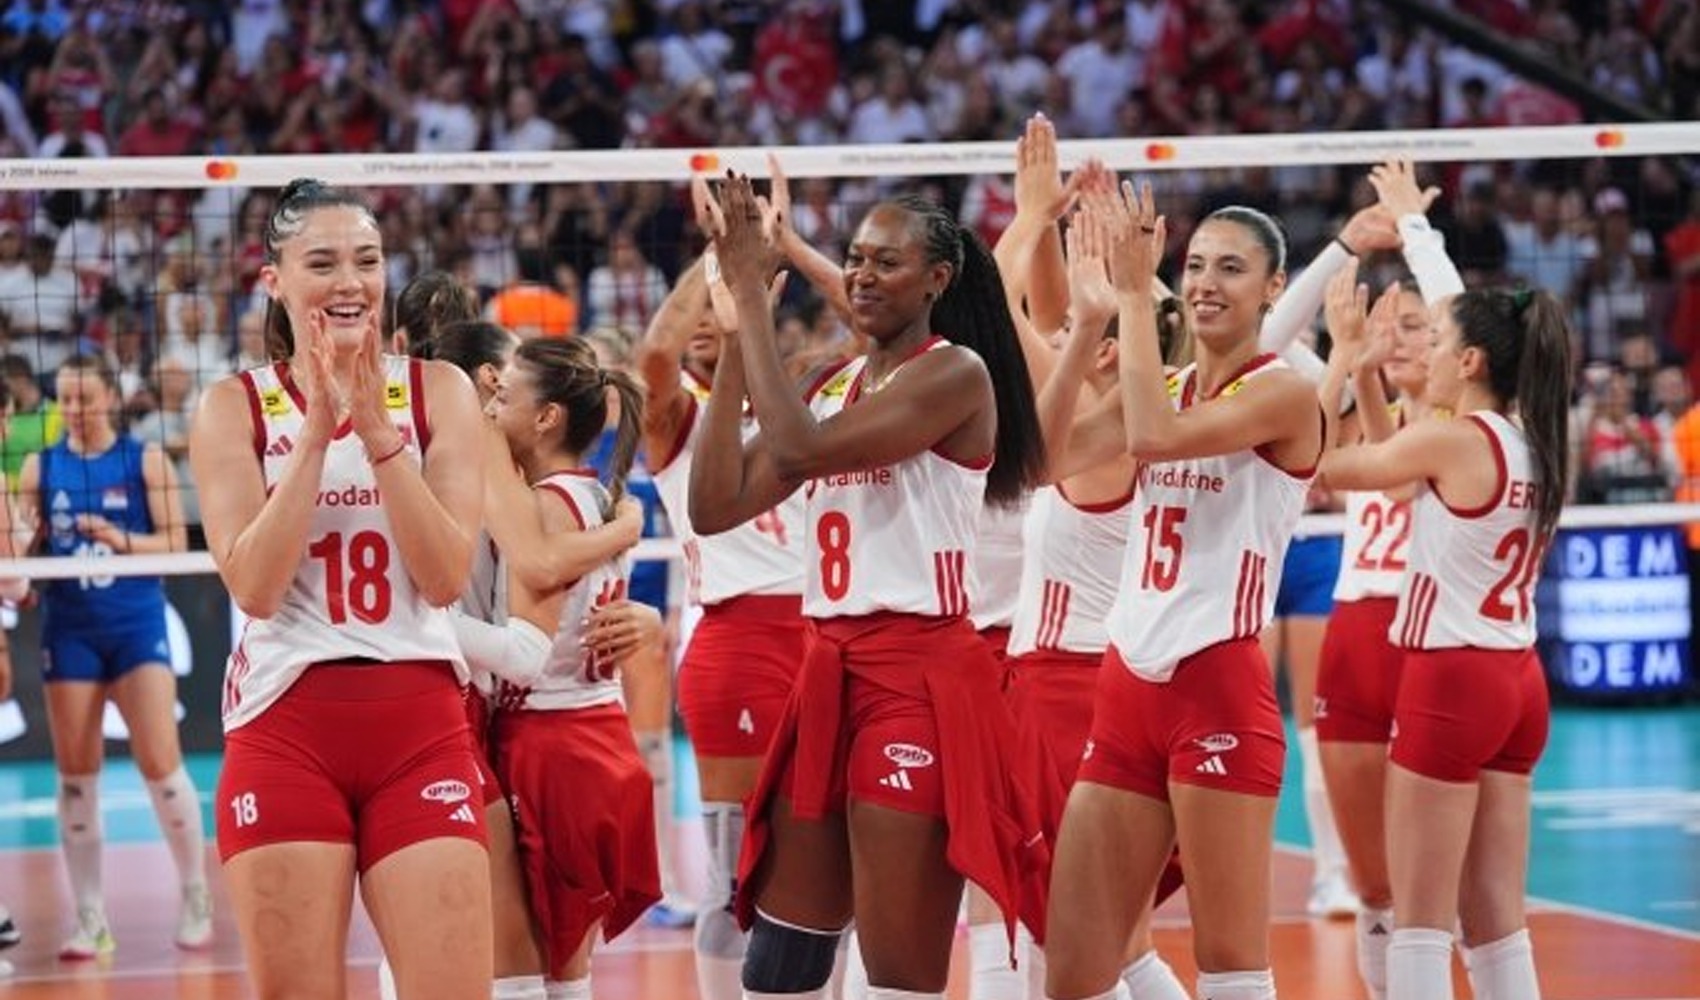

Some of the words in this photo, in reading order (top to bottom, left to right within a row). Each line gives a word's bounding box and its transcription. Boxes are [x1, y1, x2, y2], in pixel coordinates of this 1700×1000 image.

[817, 511, 850, 602] 8
[1142, 505, 1187, 592] 15
[1355, 501, 1412, 570] 22
[309, 530, 391, 625] 18
[738, 708, 754, 734] 4
[231, 792, 259, 828] 18
